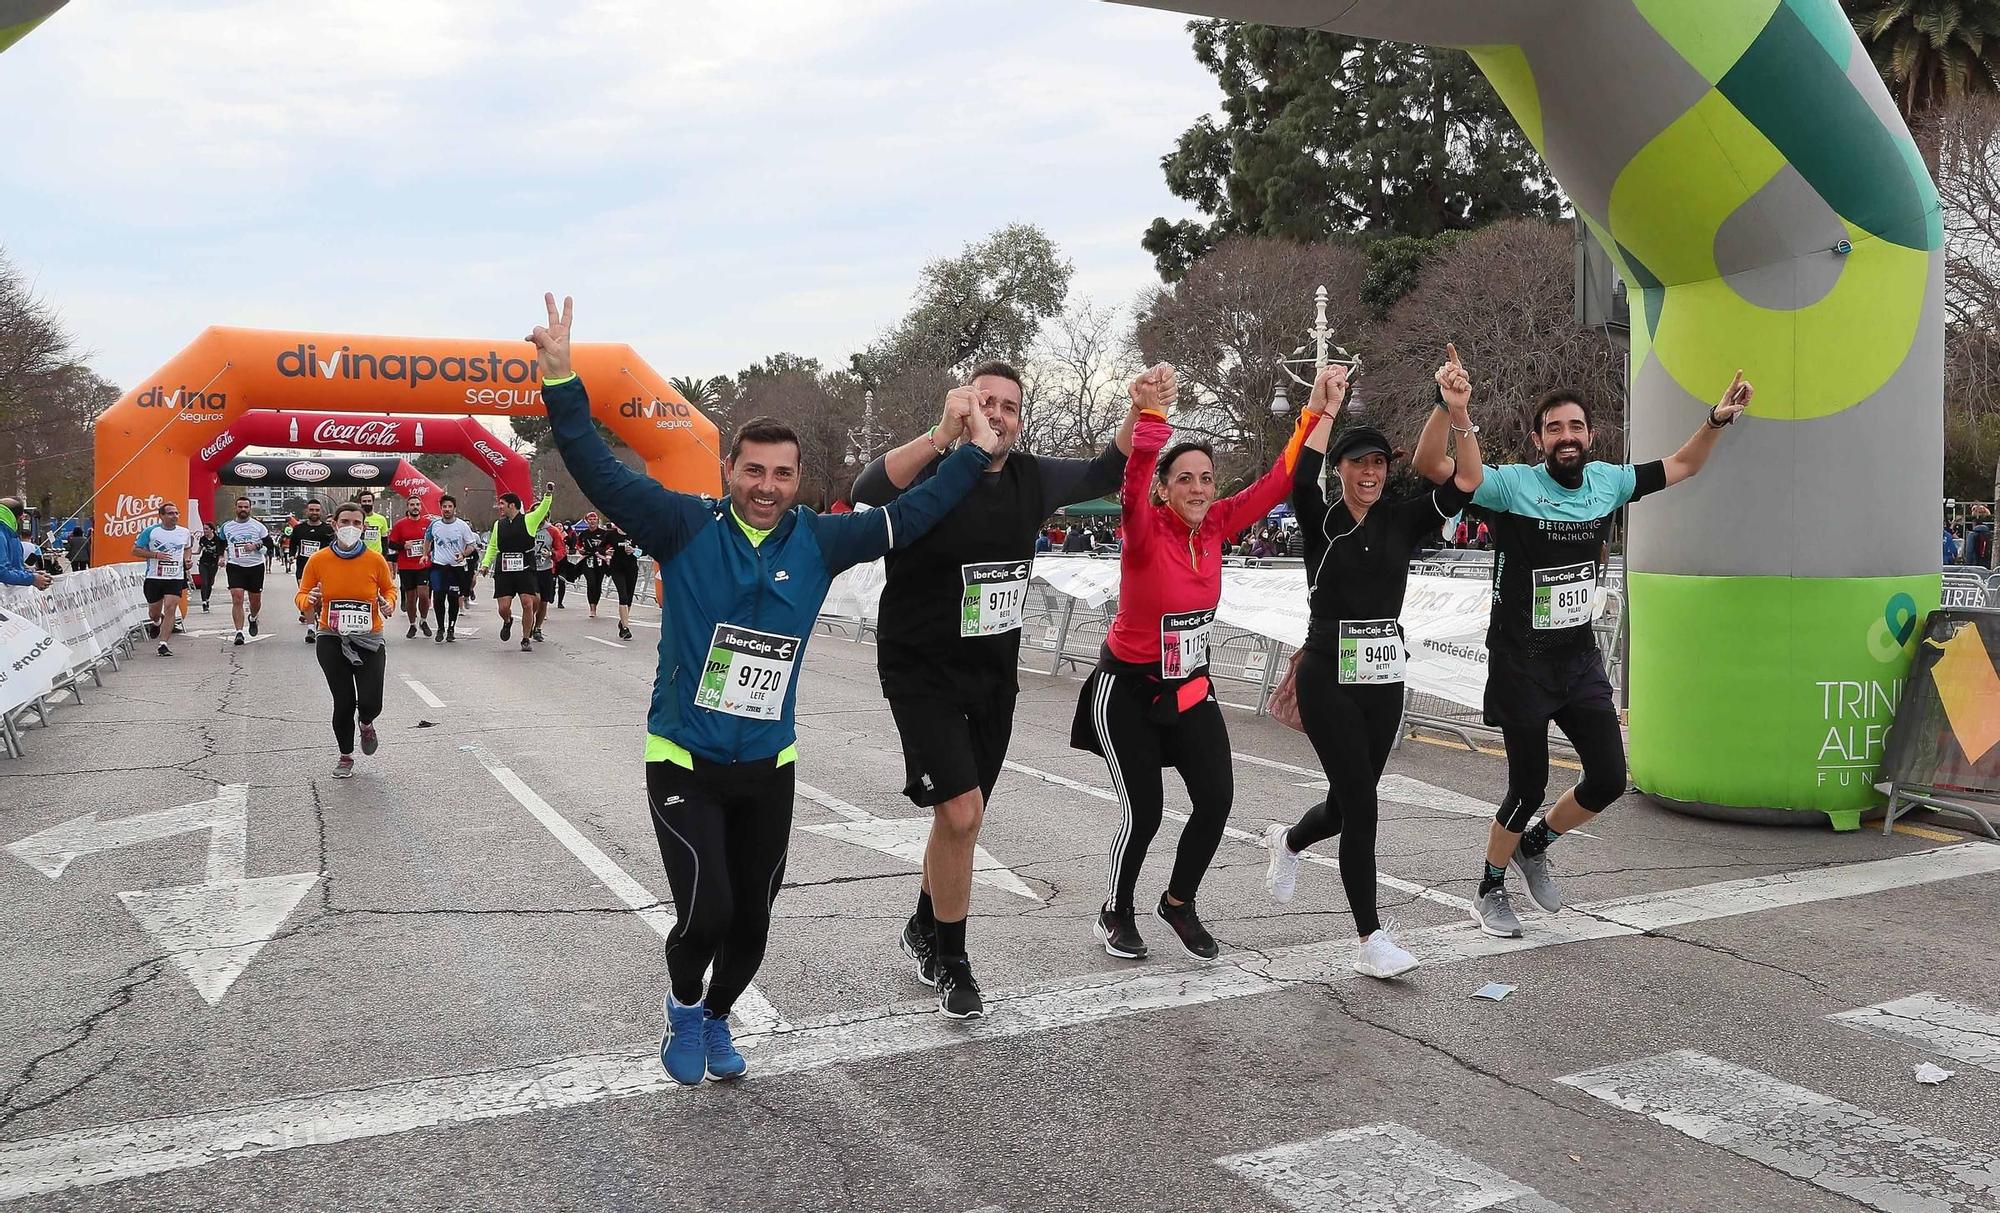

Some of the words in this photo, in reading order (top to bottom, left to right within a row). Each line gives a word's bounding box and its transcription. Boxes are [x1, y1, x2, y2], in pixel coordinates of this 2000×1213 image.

[137, 385, 226, 410] divina
[619, 397, 690, 418] divina
[180, 412, 224, 424] seguros
[656, 420, 692, 430] seguros
[239, 467, 264, 476] Serrano
[291, 465, 327, 477] Serrano
[352, 467, 378, 476] Serrano
[116, 493, 146, 518] No
[145, 494, 163, 511] te
[1547, 532, 1595, 541] TRIATHLON
[972, 569, 1009, 580] iberCaja
[1542, 571, 1575, 582] iberCaja
[989, 589, 1019, 611] 9719
[1558, 588, 1588, 608] 8510
[341, 614, 369, 625] 11156
[1348, 626, 1382, 636] iberCaja
[725, 634, 772, 654] iberCaja
[1422, 638, 1488, 664] #notedete
[12, 636, 54, 672] #note
[1365, 644, 1397, 663] 9400
[737, 665, 782, 692] 9720
[705, 688, 720, 702] 04
[750, 691, 766, 701] LETE
[1816, 679, 1903, 719] TRINI
